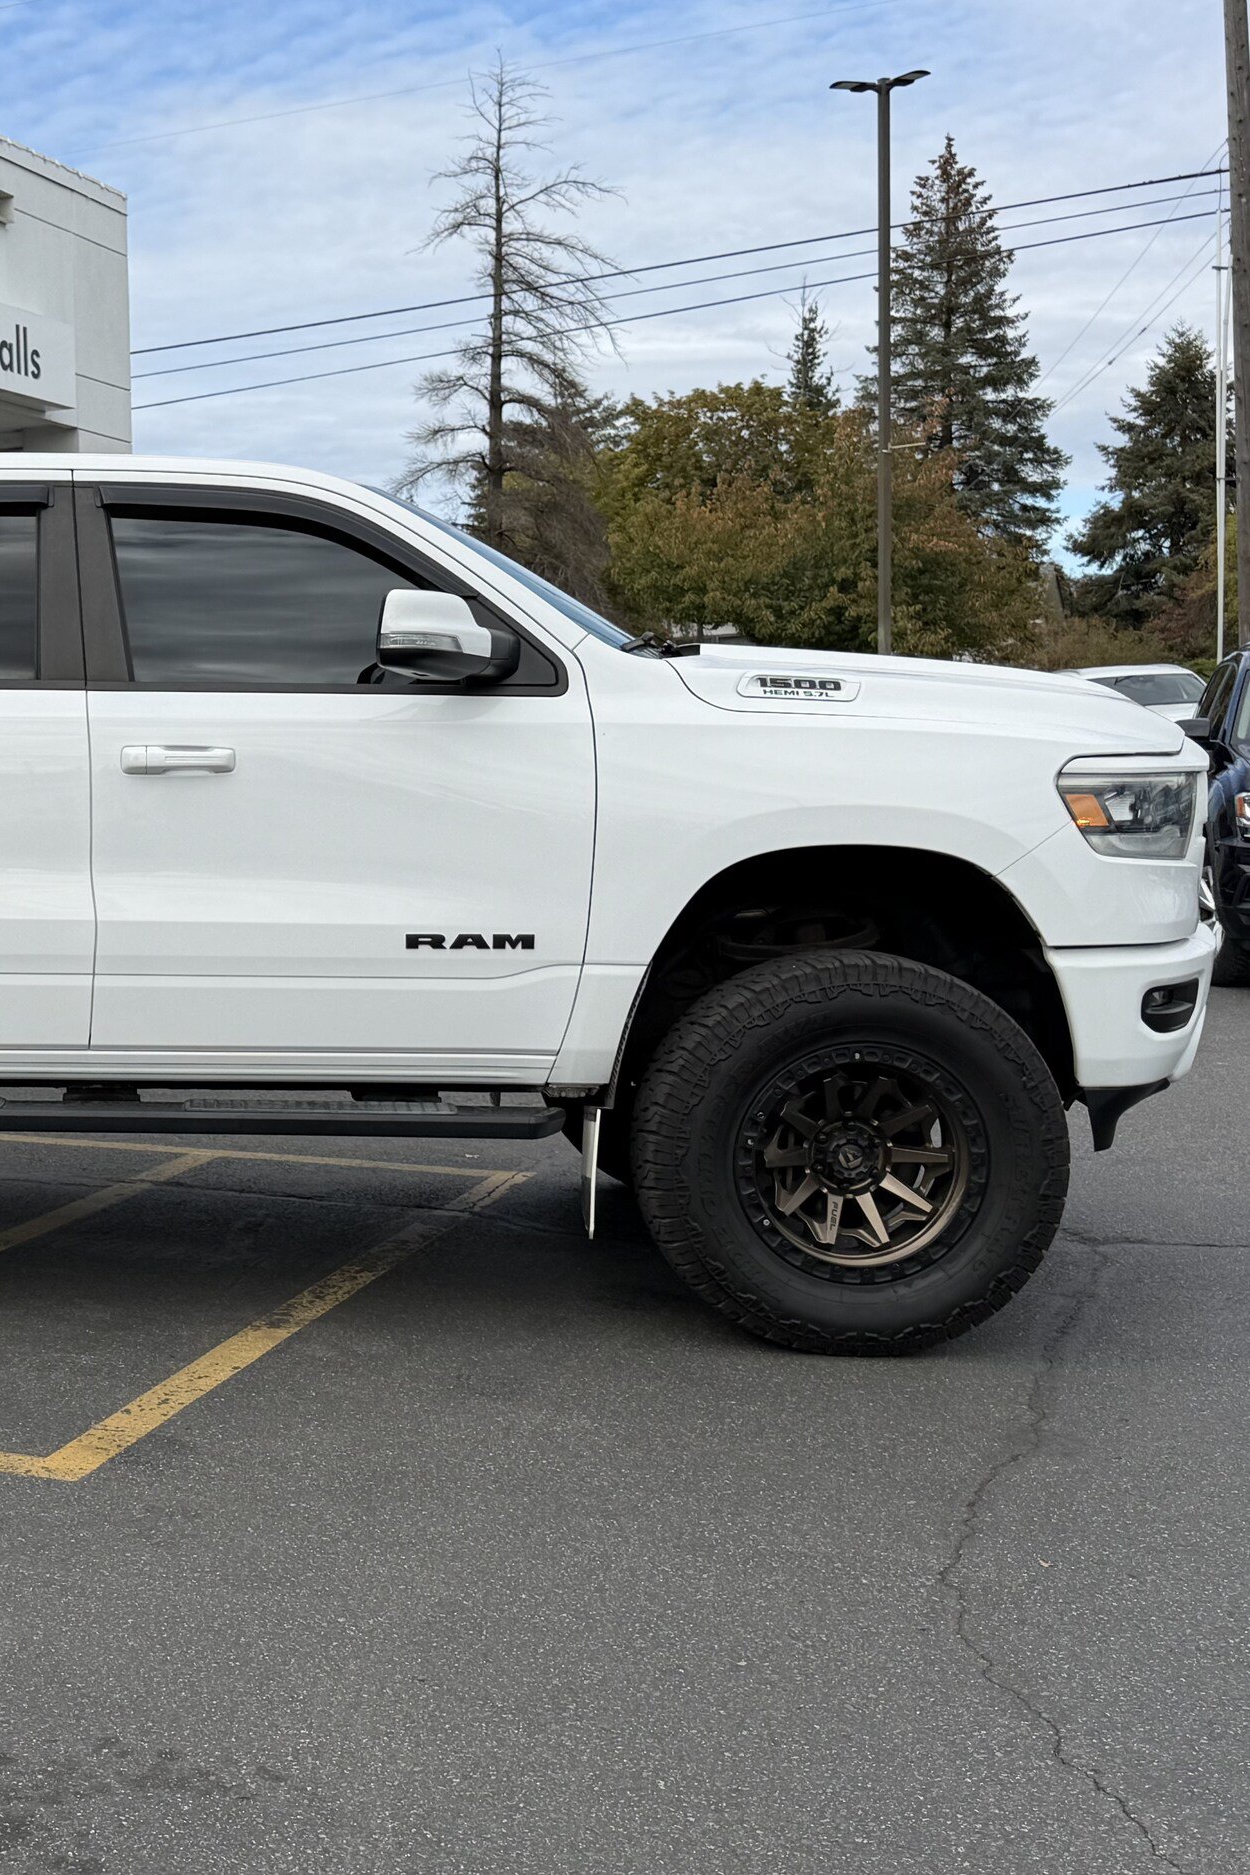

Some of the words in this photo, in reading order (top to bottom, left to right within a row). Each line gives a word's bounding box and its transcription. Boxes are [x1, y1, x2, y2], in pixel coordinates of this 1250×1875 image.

[756, 677, 841, 691] 1500
[405, 933, 535, 950] RAM
[829, 1201, 840, 1232] FUEL
